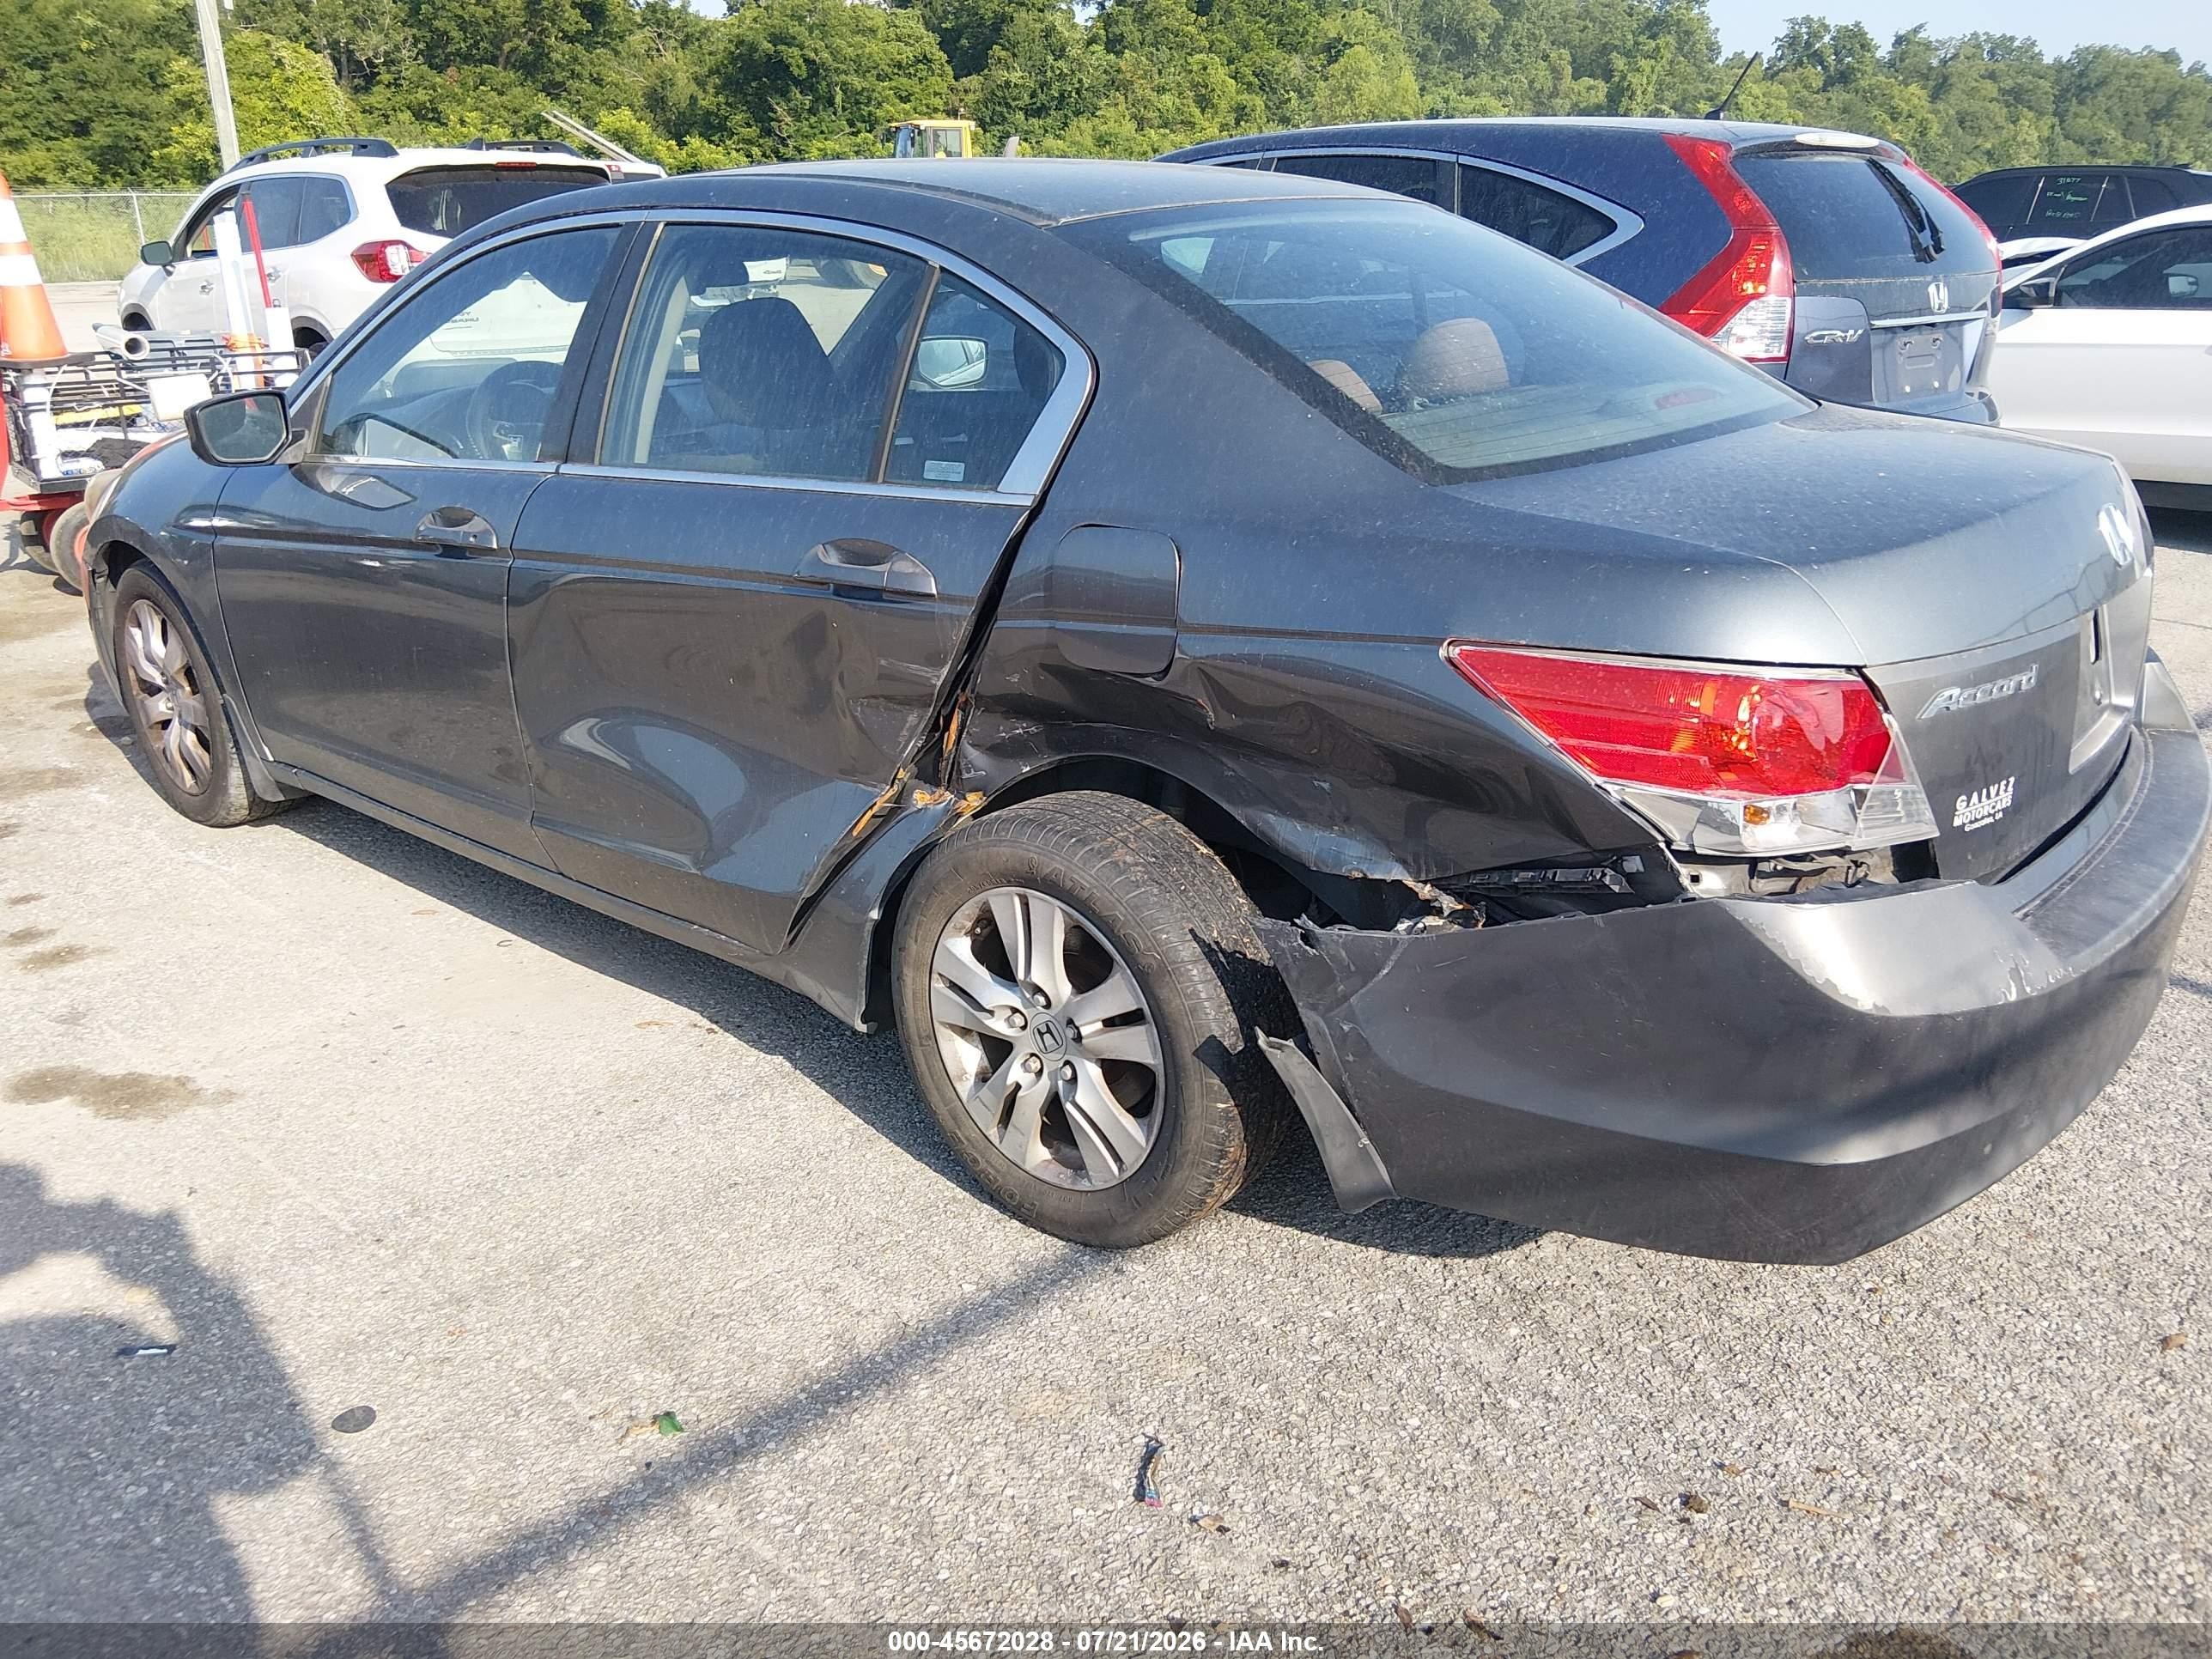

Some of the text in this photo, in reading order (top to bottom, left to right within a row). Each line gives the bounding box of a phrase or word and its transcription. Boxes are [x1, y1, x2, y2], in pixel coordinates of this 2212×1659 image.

[1916, 664, 2039, 720] Accord
[1952, 794, 2013, 827] MOTORCARS
[1955, 775, 2015, 811] GALVEZ
[1995, 811, 2003, 820] LA
[1042, 865, 1144, 955] ATLAS
[947, 1130, 1038, 1218] FORCE
